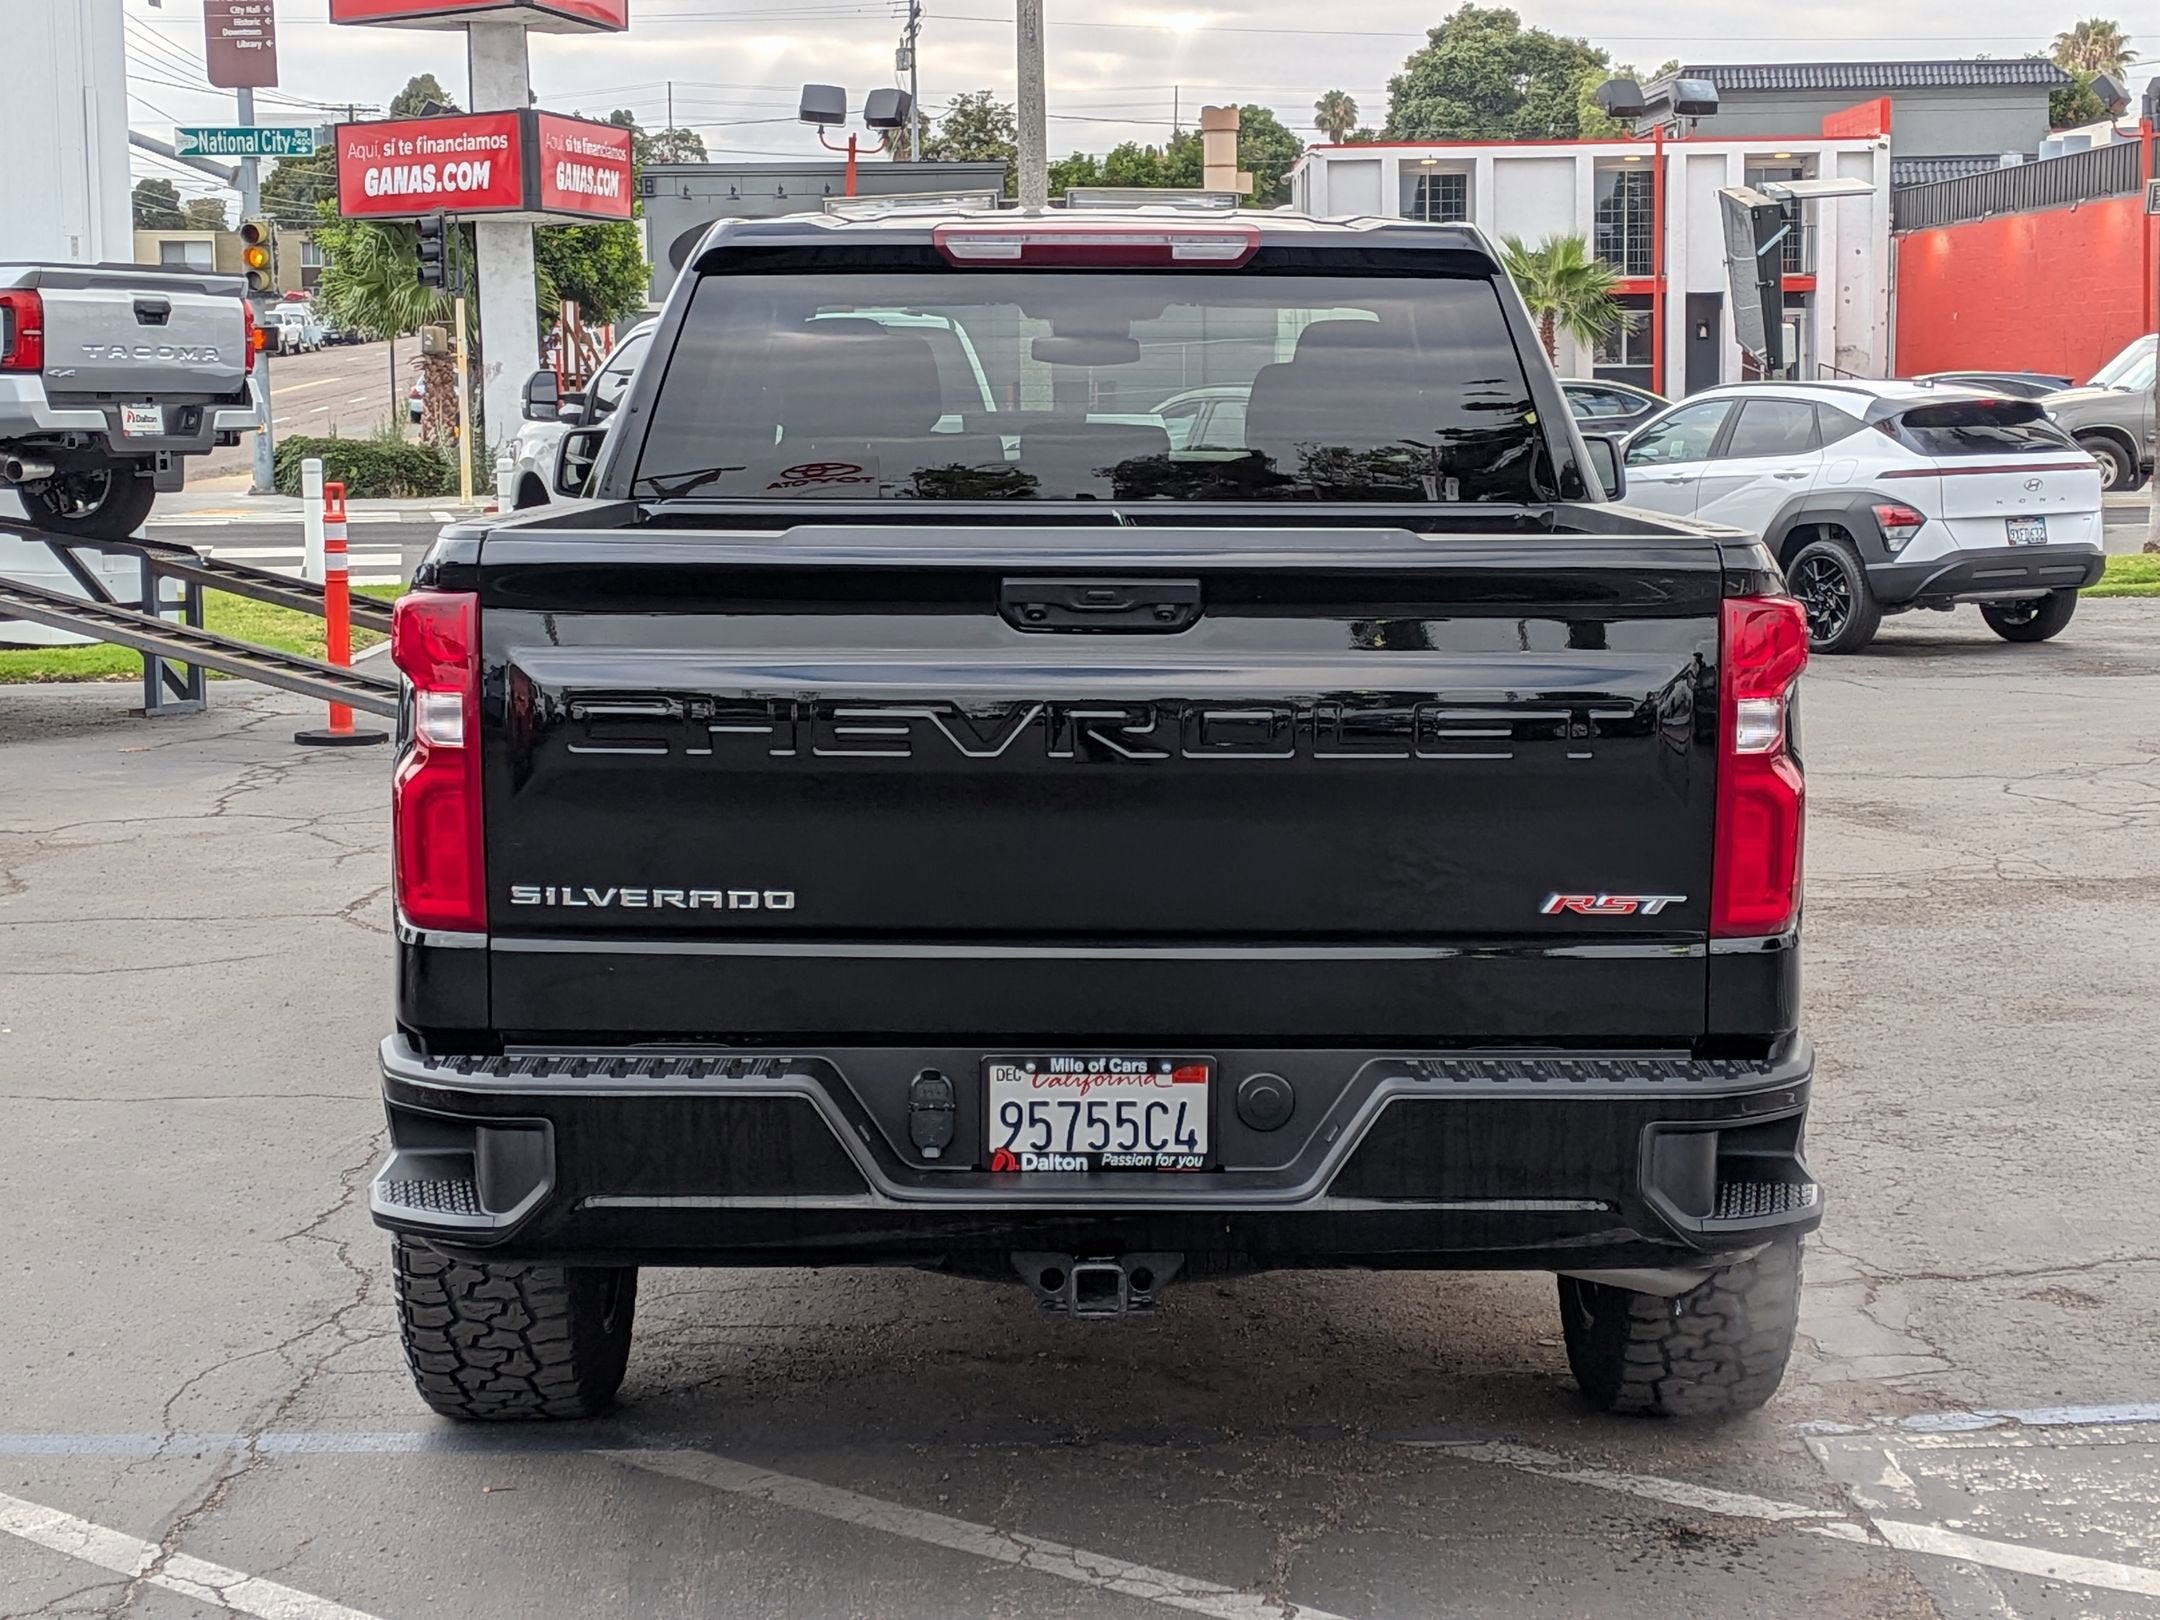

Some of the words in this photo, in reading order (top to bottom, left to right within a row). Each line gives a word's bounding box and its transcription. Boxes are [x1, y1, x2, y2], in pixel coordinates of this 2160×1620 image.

[230, 6, 245, 15] City
[246, 5, 261, 13] Hall
[236, 40, 262, 50] Library
[198, 130, 259, 154] National
[261, 130, 291, 154] City
[291, 137, 312, 146] 2400
[347, 142, 381, 161] Aquí,
[383, 138, 397, 156] sí
[398, 138, 413, 156] te
[416, 132, 508, 155] financiamos
[573, 138, 582, 154] te
[582, 137, 627, 162] financiamos
[364, 160, 491, 198] GANAS.COM
[556, 161, 620, 198] GANAS.COM
[82, 344, 220, 362] TACOMA
[135, 414, 158, 423] Dalton
[566, 698, 1636, 759] CHEVROLET
[510, 885, 796, 911] SILVERADO
[1539, 894, 1688, 915] RST
[995, 1067, 1022, 1082] DEC
[1050, 1057, 1085, 1073] Mile
[1088, 1057, 1107, 1073] of
[1109, 1058, 1148, 1073] Cars
[1032, 1073, 1173, 1096] California
[1000, 1101, 1198, 1151] 95755C4
[1021, 1153, 1089, 1171] Dalton
[1101, 1153, 1152, 1167] Passion
[1155, 1153, 1175, 1167] for
[1175, 1155, 1204, 1170] you
